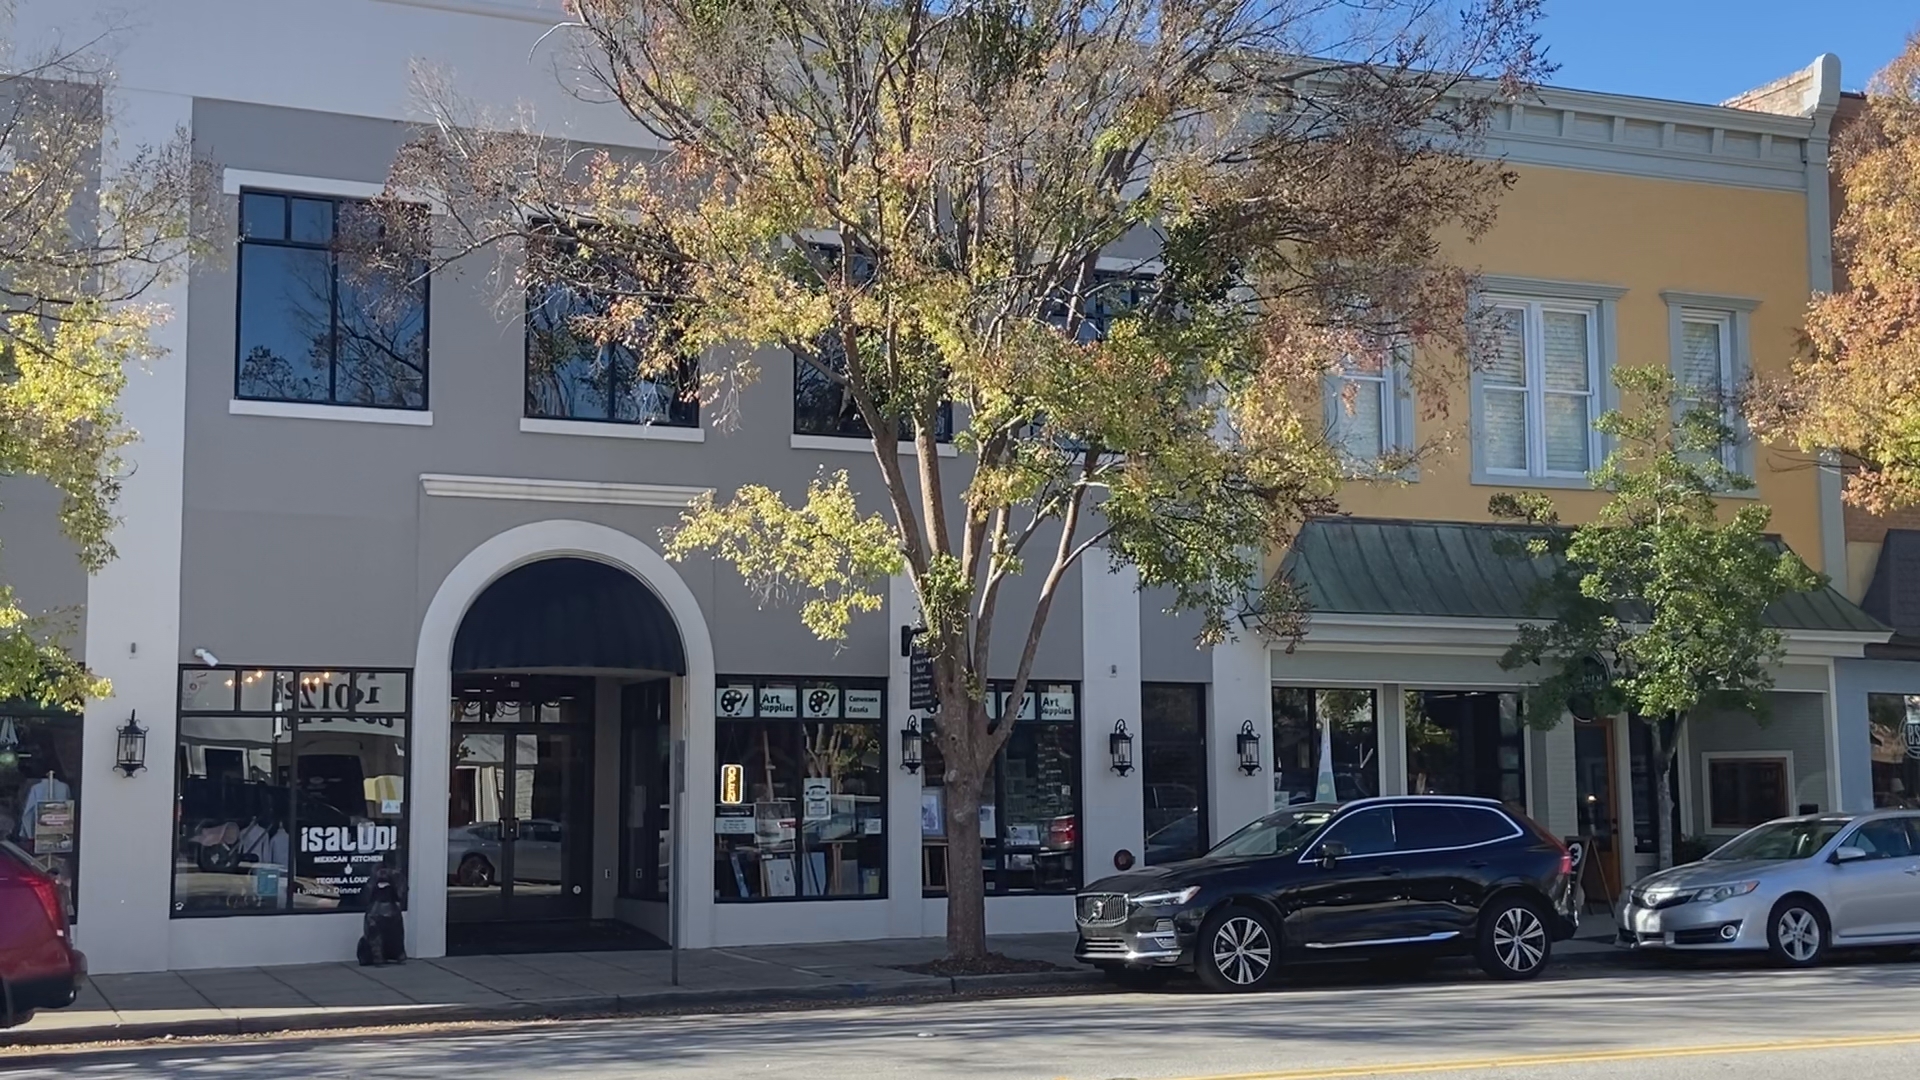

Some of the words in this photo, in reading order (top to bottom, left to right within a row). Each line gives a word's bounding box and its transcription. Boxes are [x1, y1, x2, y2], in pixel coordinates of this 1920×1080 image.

[762, 693, 780, 704] Art
[1043, 697, 1059, 706] Art
[760, 703, 794, 713] Supplies
[727, 766, 737, 802] OPEN
[314, 855, 348, 863] MEXICAN
[350, 854, 383, 862] KITCHEN
[297, 887, 324, 895] Lunch
